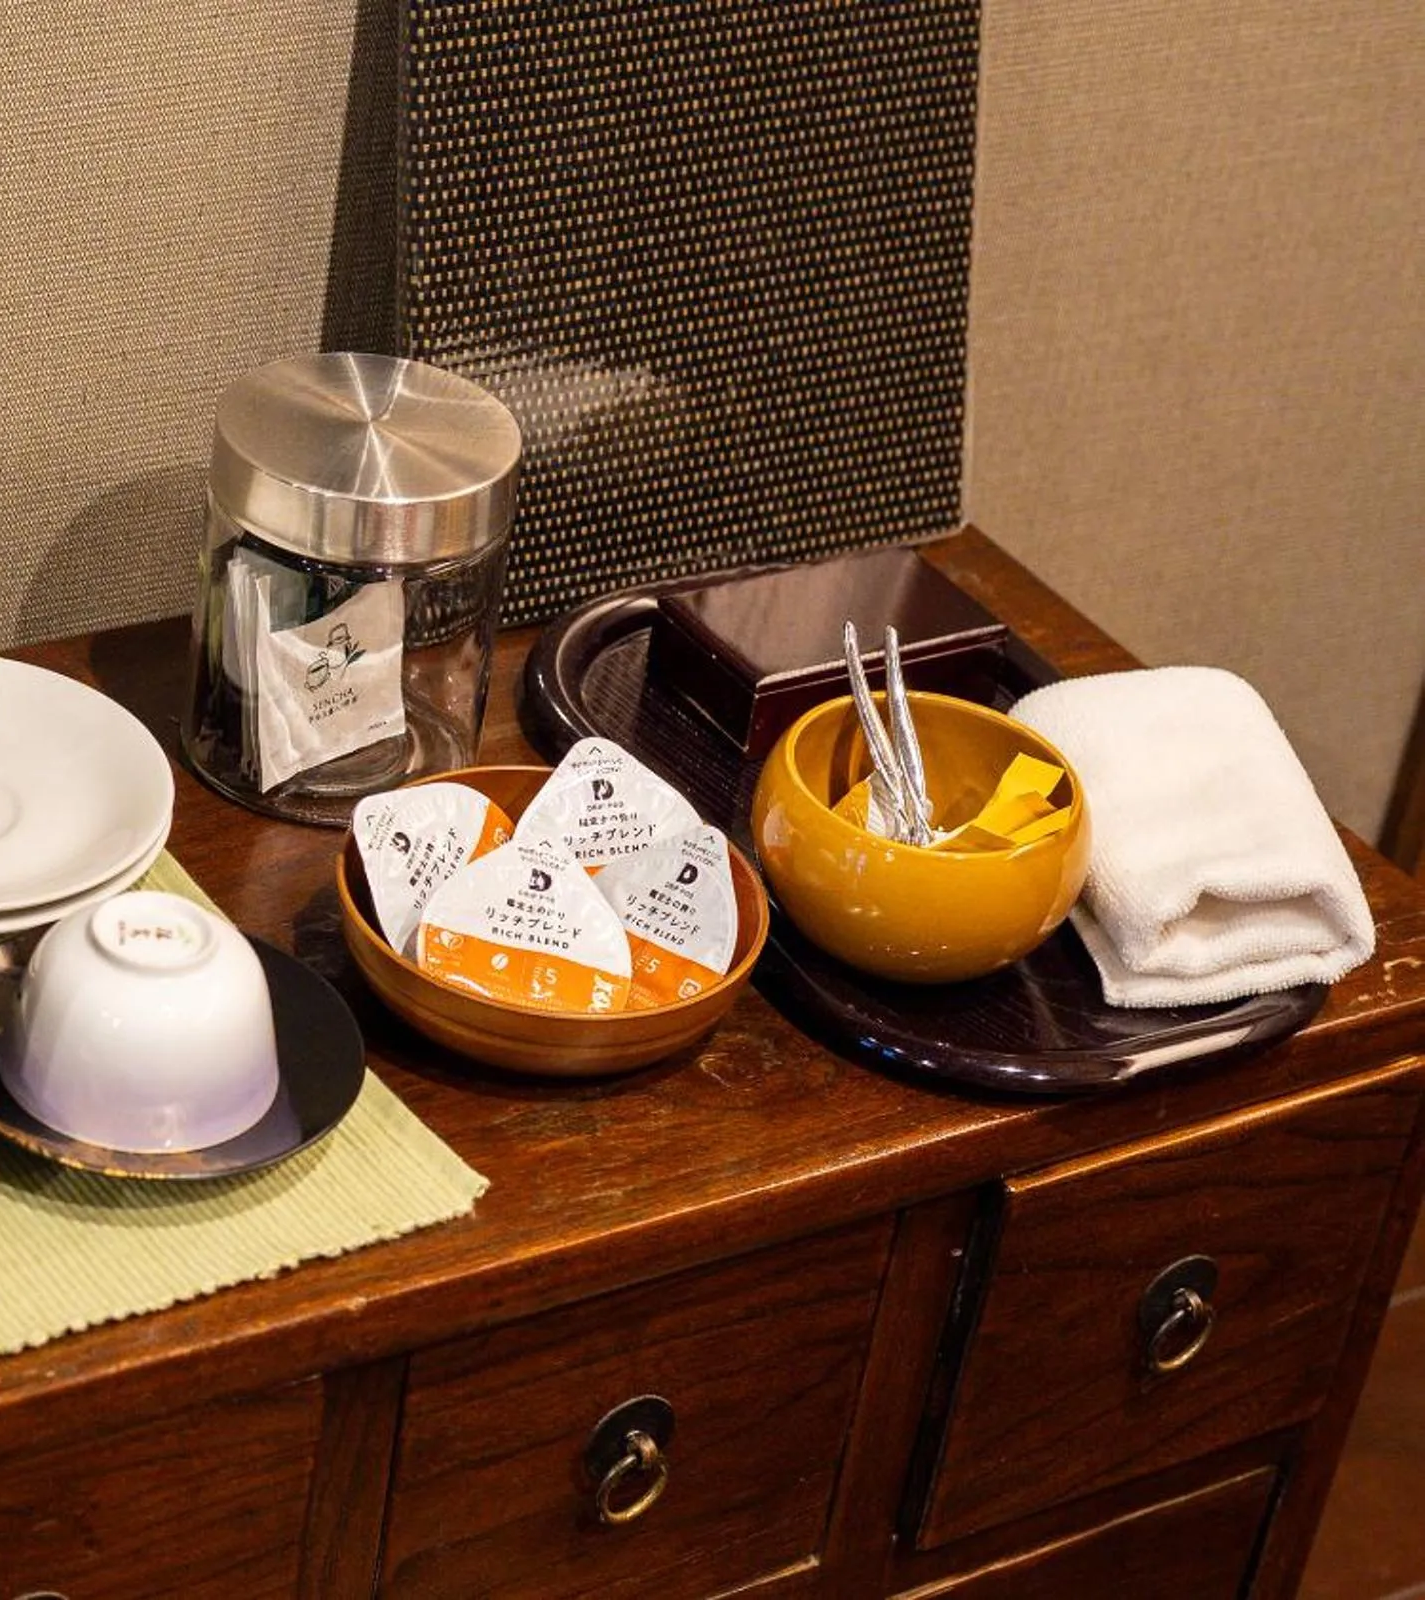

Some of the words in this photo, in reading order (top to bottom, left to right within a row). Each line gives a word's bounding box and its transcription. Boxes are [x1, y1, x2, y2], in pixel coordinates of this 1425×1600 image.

[563, 824, 657, 847] リッチブレンド
[413, 827, 457, 910] リッチブレンド
[574, 848, 604, 859] RICH
[485, 906, 583, 939] リッチブレンド
[625, 913, 651, 931] RICH
[653, 928, 685, 946] BLEND
[626, 894, 701, 936] リッチブレンド
[491, 927, 523, 940] RICH
[528, 934, 569, 949] BLEND
